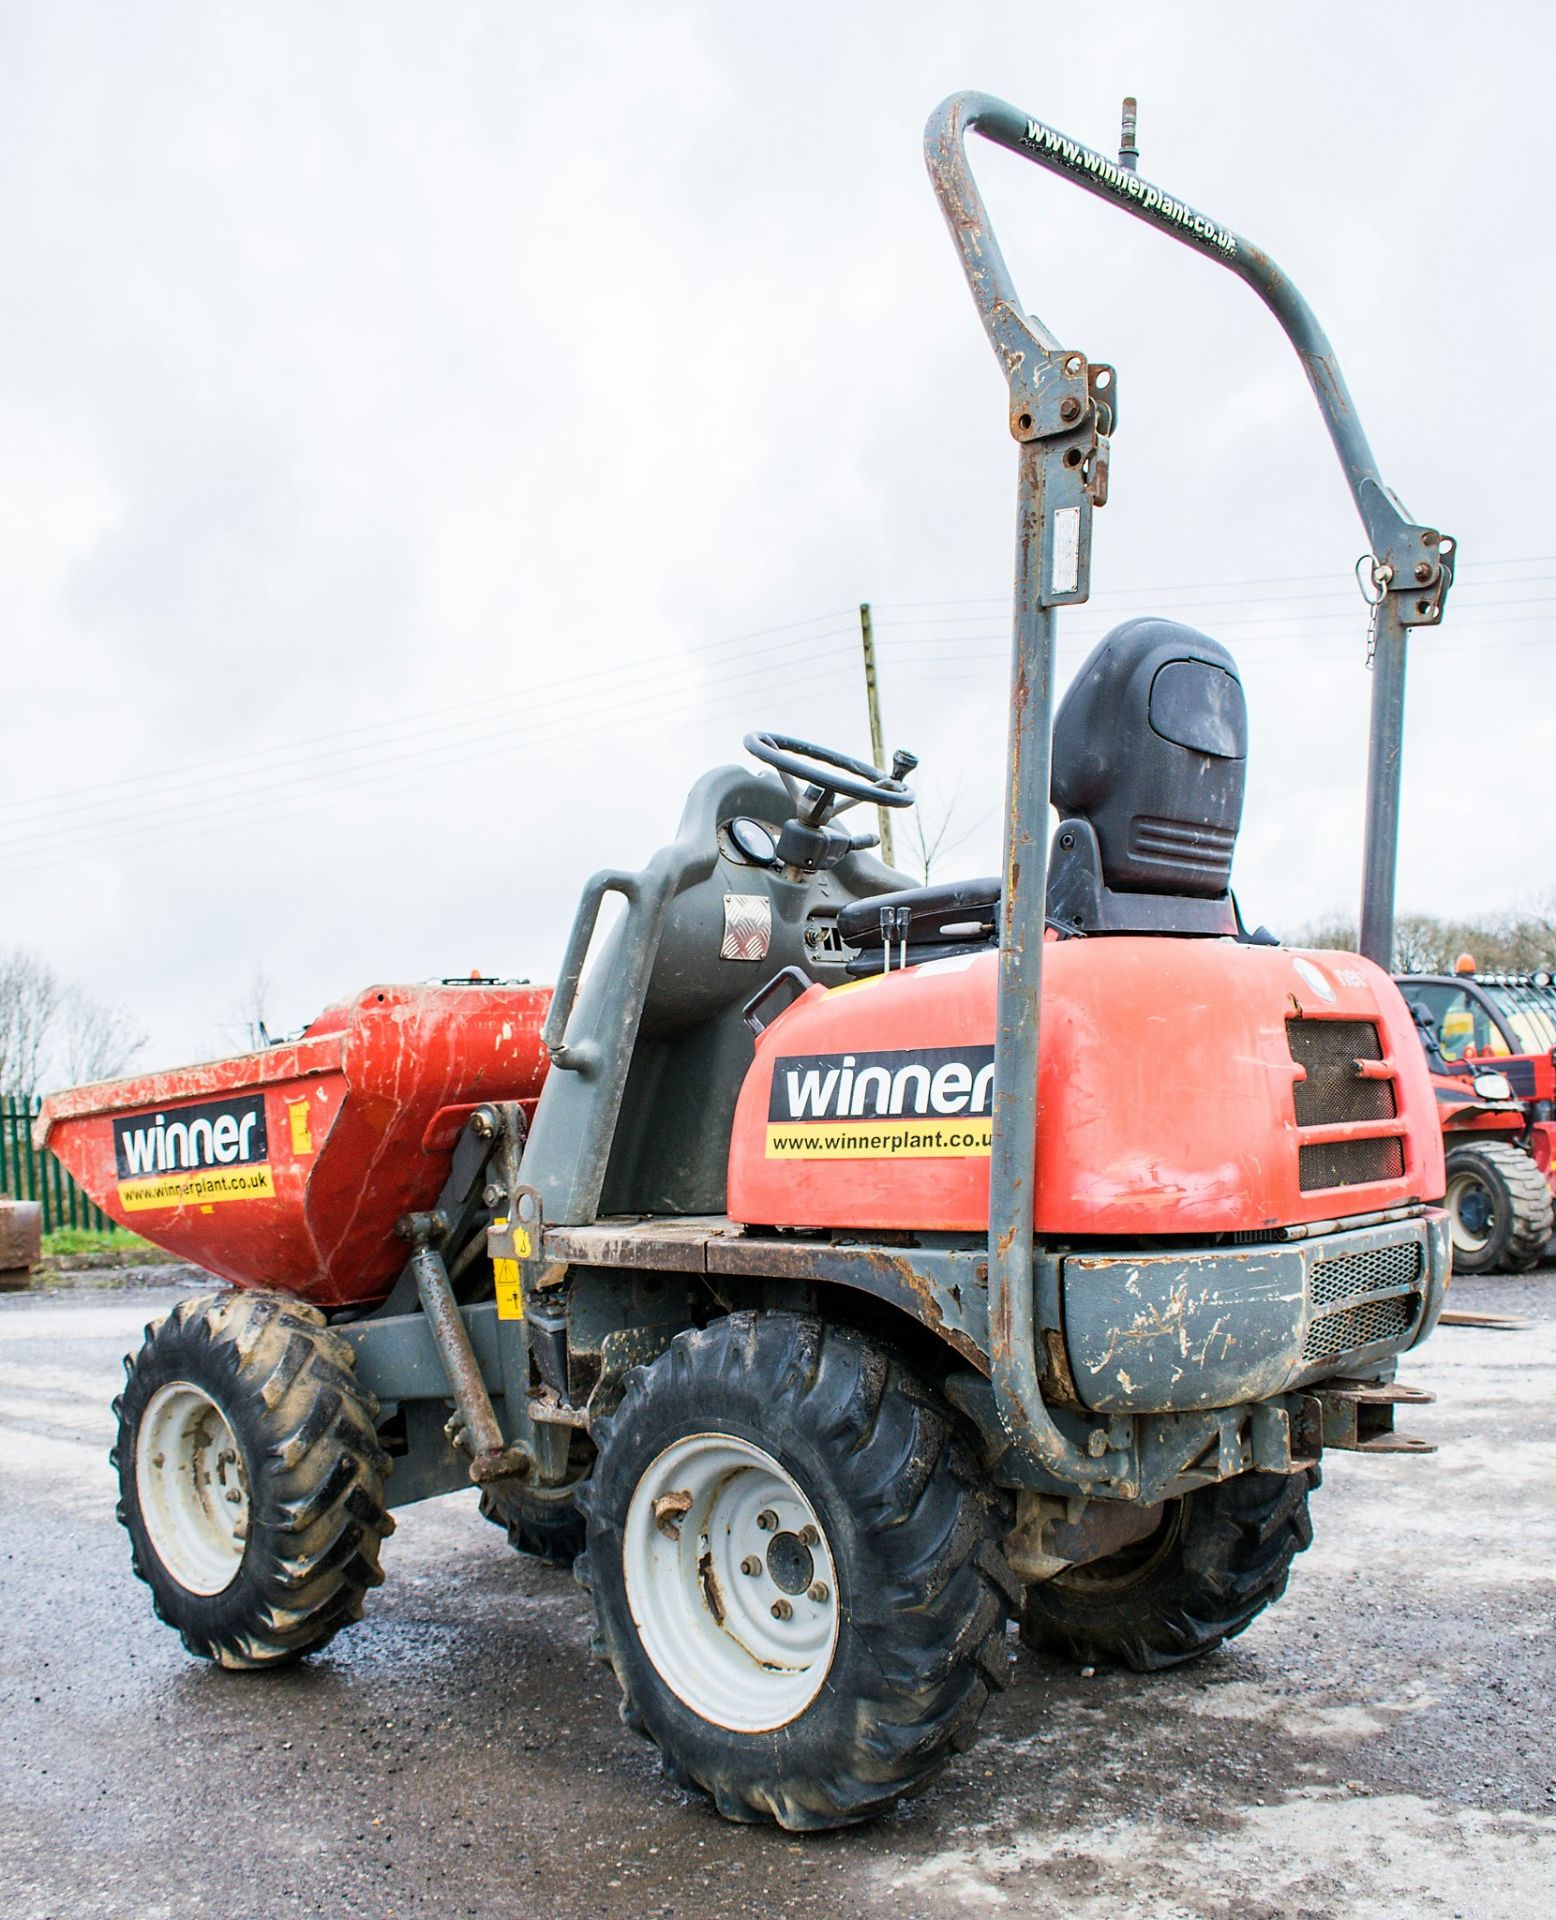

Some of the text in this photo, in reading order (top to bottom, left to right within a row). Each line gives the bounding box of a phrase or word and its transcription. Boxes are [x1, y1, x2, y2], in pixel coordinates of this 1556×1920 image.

[786, 1056, 995, 1117] winner
[123, 1112, 256, 1174] winner
[773, 1131, 993, 1152] www.winnerplant.co.u
[125, 1172, 267, 1201] www.winnerplant.co.uk
